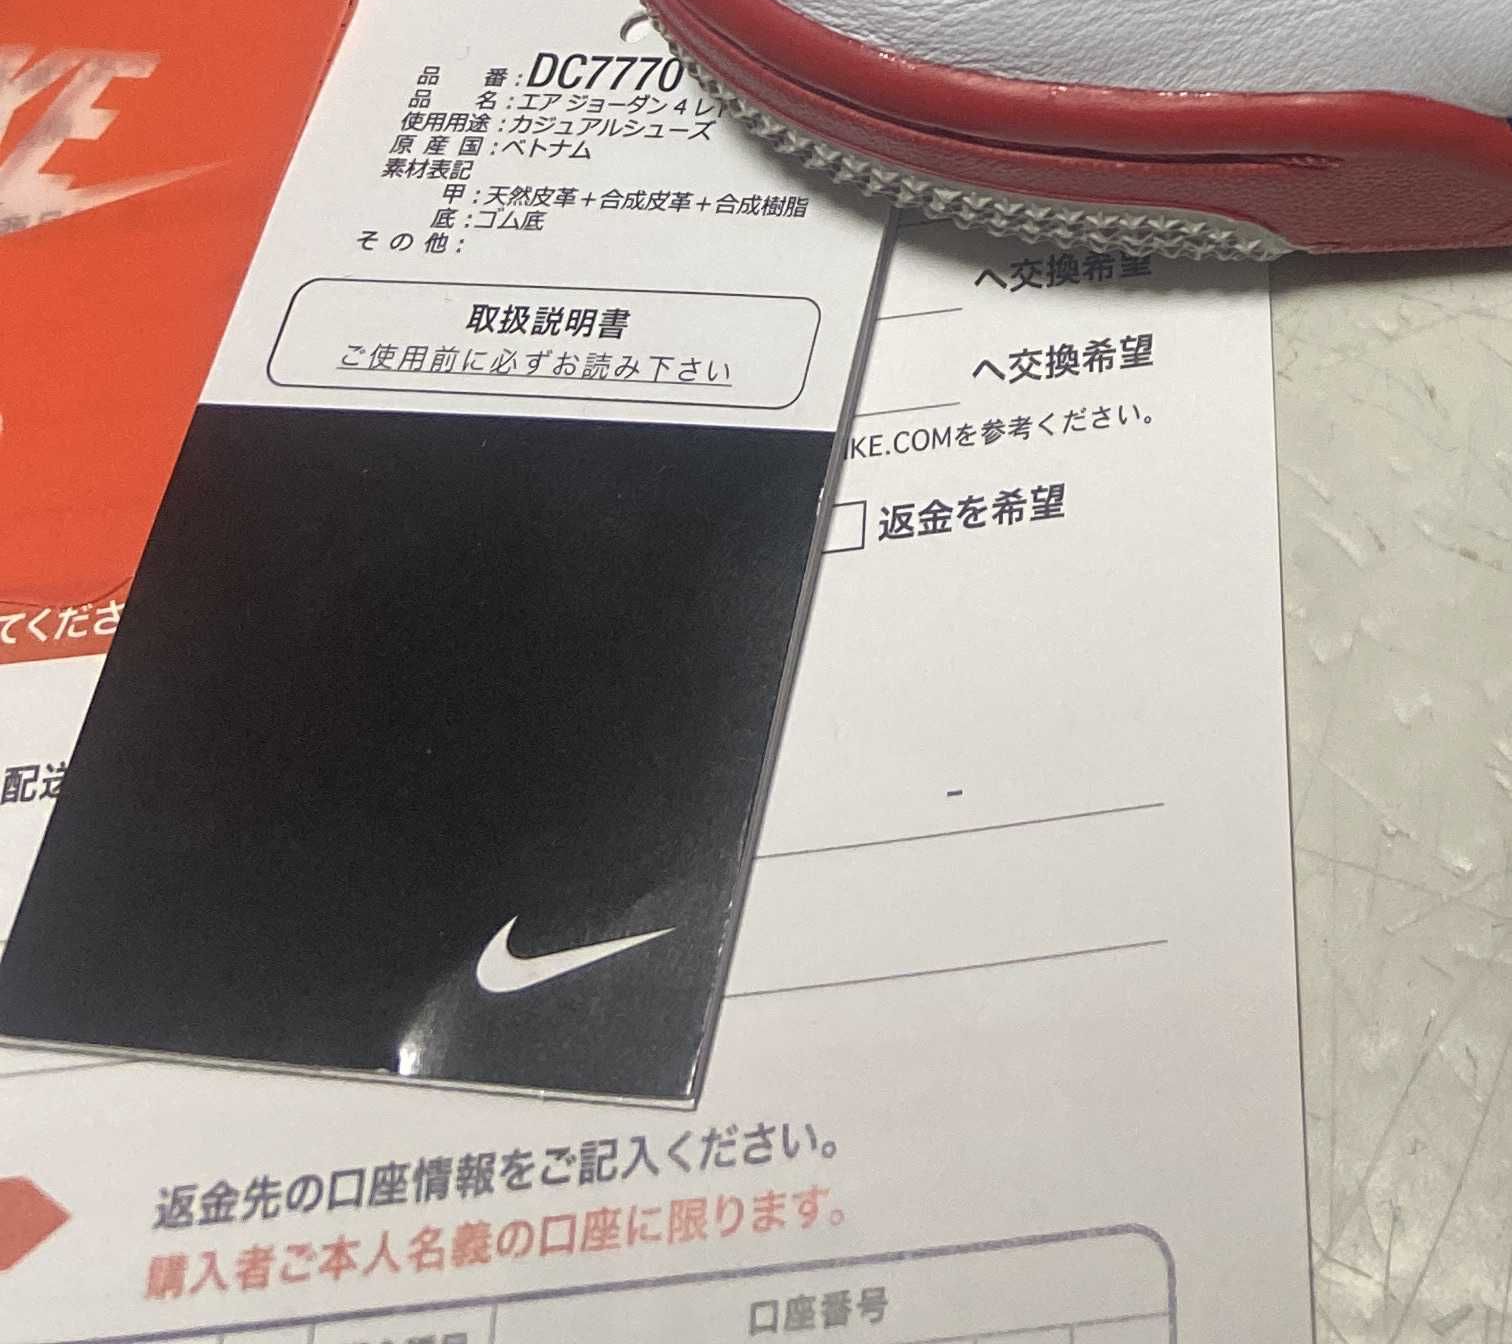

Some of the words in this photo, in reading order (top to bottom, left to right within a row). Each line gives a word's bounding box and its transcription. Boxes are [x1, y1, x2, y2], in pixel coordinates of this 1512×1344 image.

[381, 158, 474, 181] 素材表記
[465, 303, 632, 340] 取扱説明書
[338, 343, 732, 382] ご使用前に必ずお読み下さい
[971, 332, 1155, 384] へ交換希望
[877, 482, 1067, 542] 返金を希望
[152, 1121, 838, 1230] 返金先の口座情報をご記入ください。
[143, 1184, 845, 1300] 購入者ご本人名義の口座に限ります。
[748, 1286, 890, 1337] 口座番号
